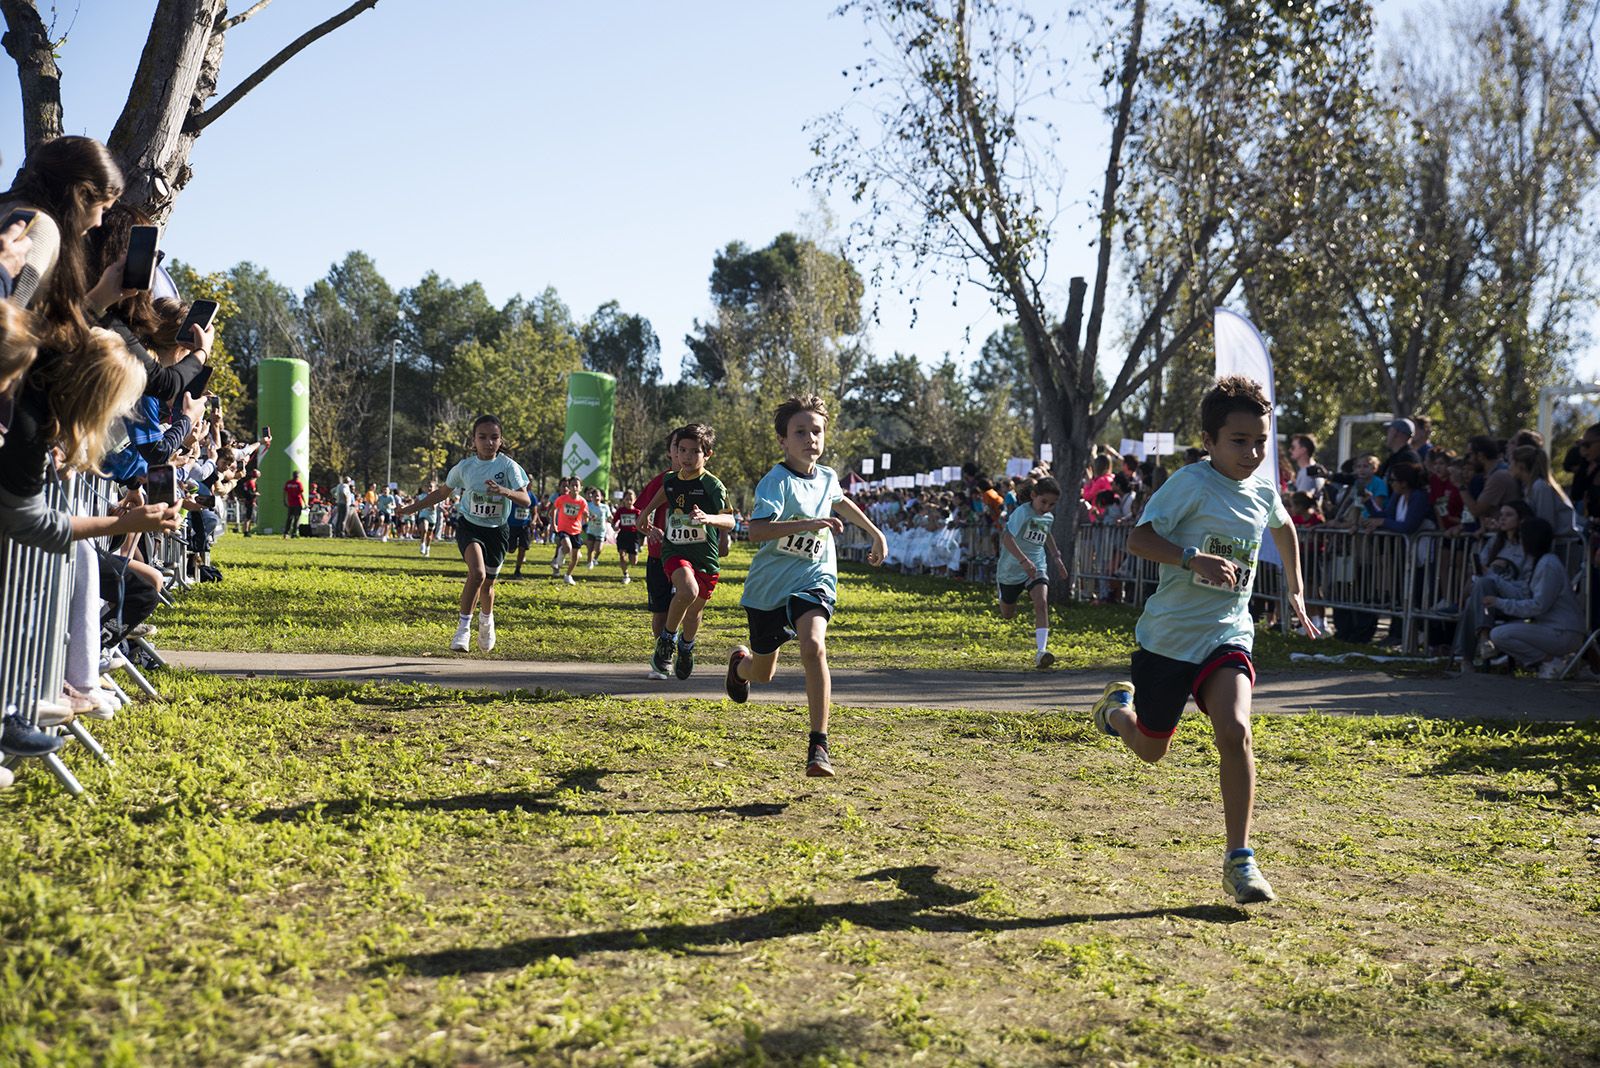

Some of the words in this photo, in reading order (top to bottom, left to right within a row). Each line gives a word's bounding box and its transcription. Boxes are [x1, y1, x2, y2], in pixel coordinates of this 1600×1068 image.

[475, 504, 496, 515] 1187
[671, 528, 698, 539] 4700
[786, 534, 821, 554] 1426
[1209, 544, 1233, 555] CROS
